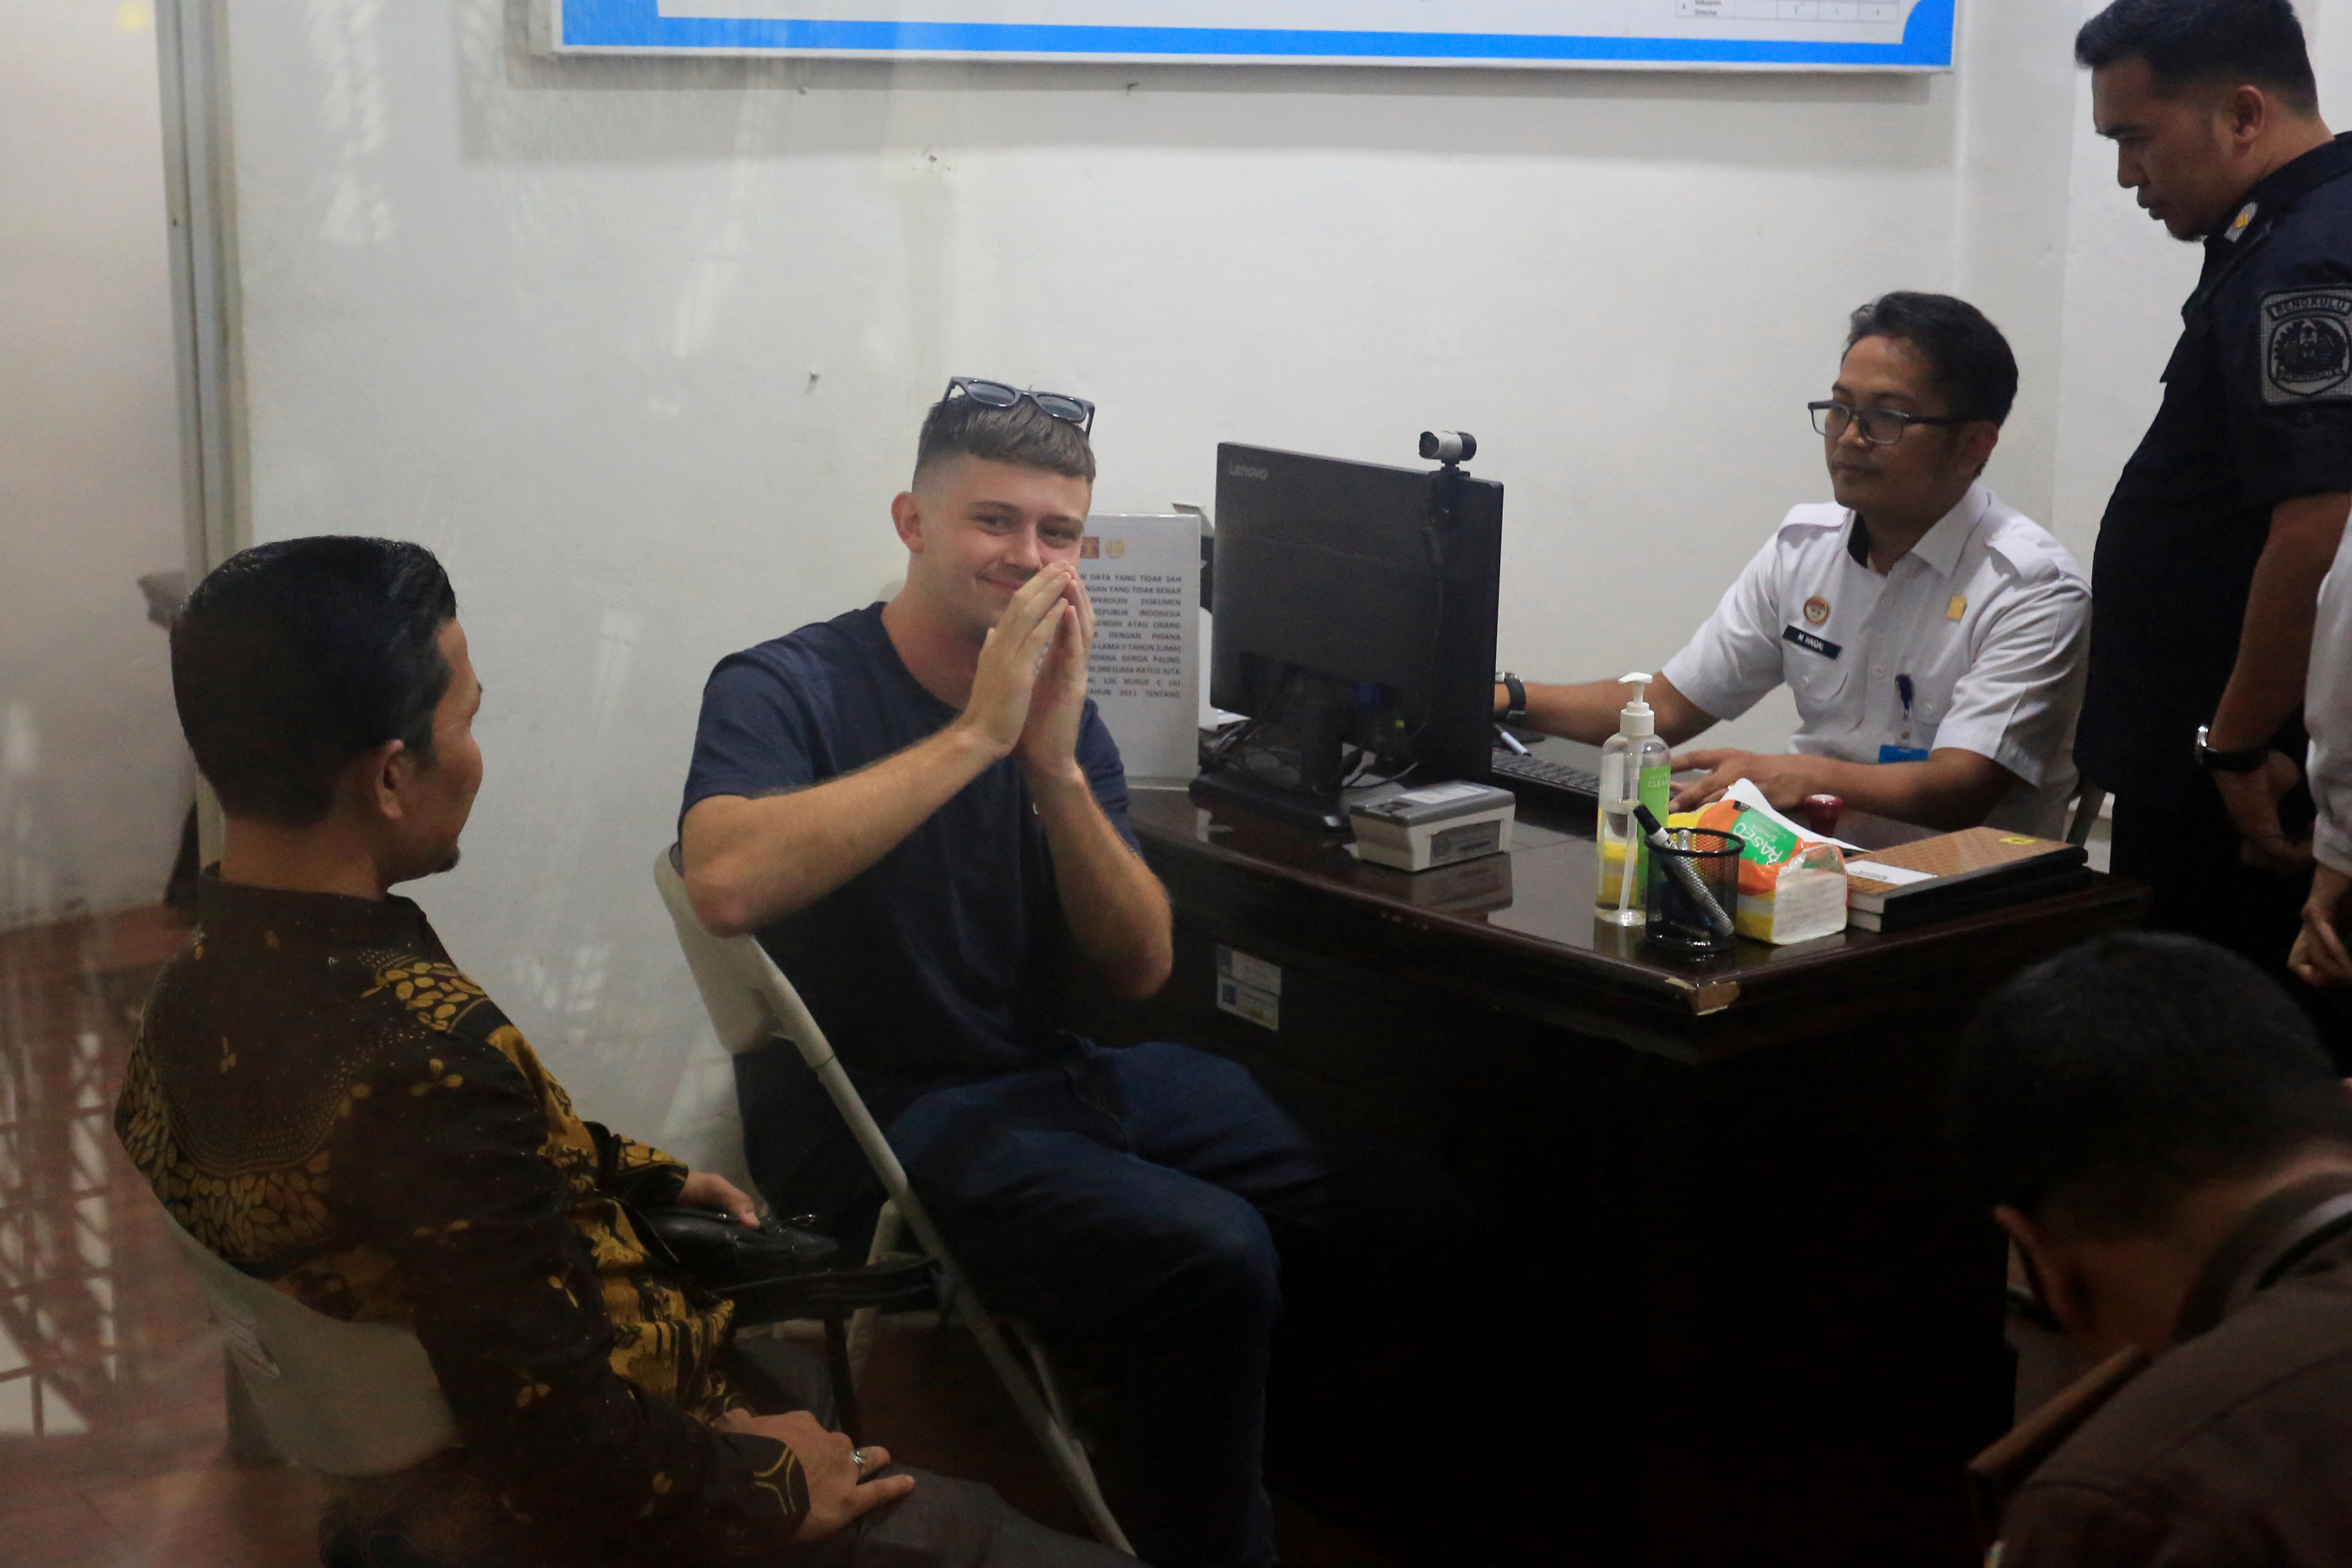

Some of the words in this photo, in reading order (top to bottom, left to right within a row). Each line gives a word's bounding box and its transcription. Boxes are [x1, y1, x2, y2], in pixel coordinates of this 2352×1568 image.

[1229, 462, 1267, 480] Lenovo
[1144, 690, 1180, 698] TENTANG
[1733, 823, 1783, 863] PASEO
